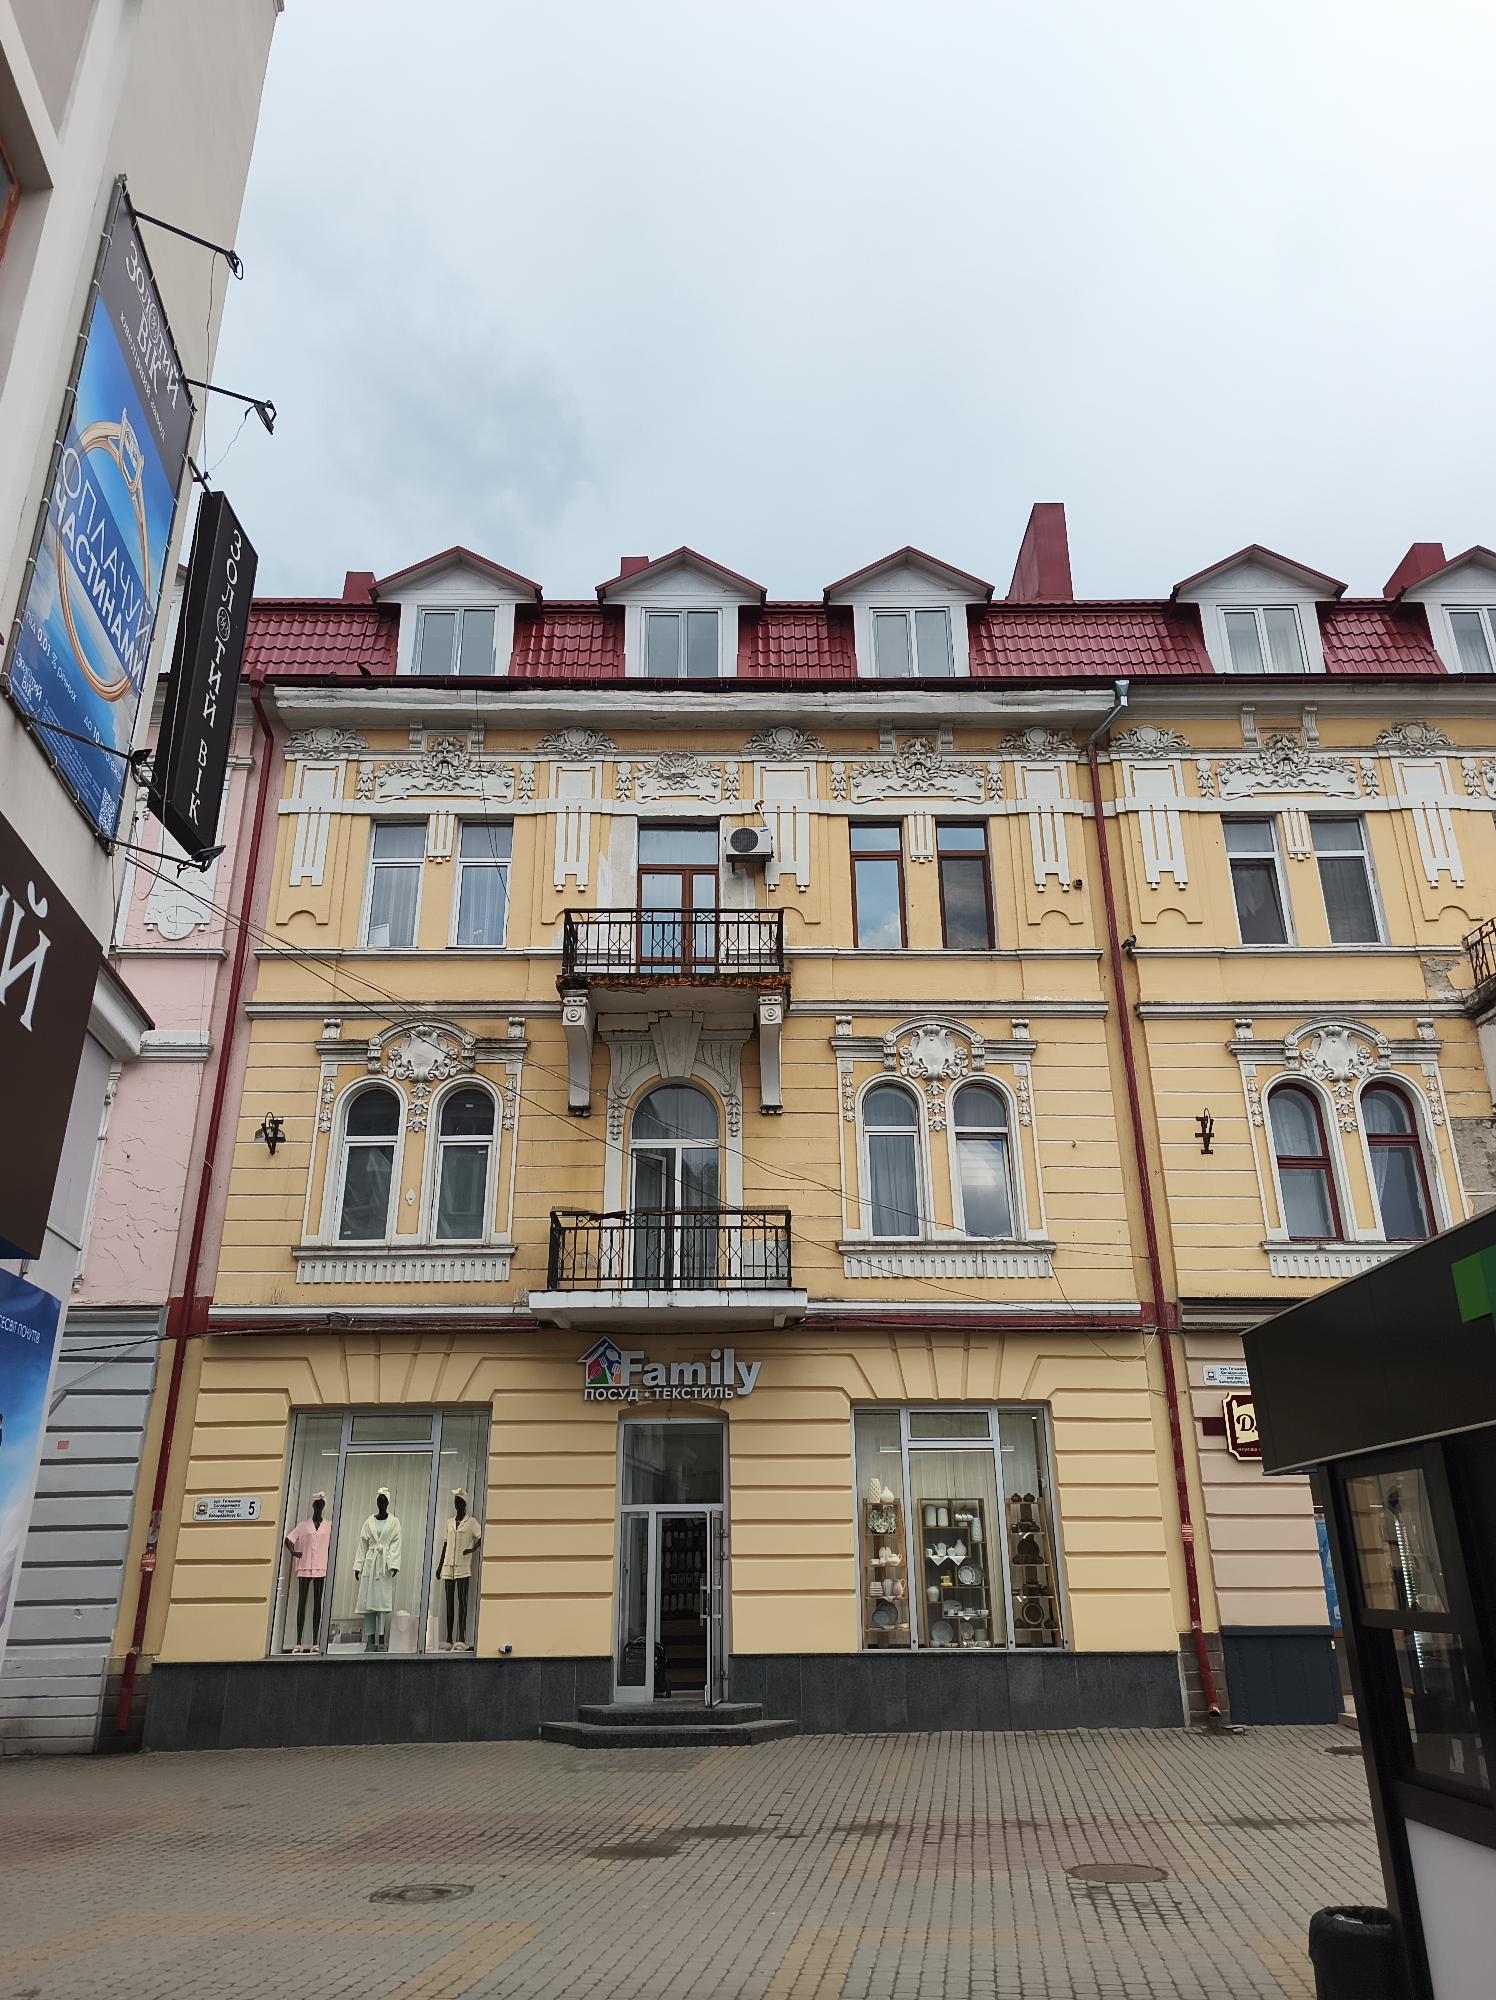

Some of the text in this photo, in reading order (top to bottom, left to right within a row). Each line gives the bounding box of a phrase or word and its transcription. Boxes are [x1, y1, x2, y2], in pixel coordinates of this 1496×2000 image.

[62, 447, 151, 655] ОПЛАЧУЙ
[55, 482, 144, 686] ЧАСТИНАМИ
[26, 610, 36, 634] під
[51, 652, 58, 669] %
[57, 666, 77, 703] річних
[83, 716, 92, 731] до
[93, 726, 100, 744] 10
[188, 738, 208, 826] ВІК
[17, 1323, 41, 1344] ПОЧУТТІВ
[584, 1387, 734, 1402] ПОСУД ТЕКСТИЛЬ
[620, 1348, 762, 1396] Family
[248, 1501, 256, 1516] 5
